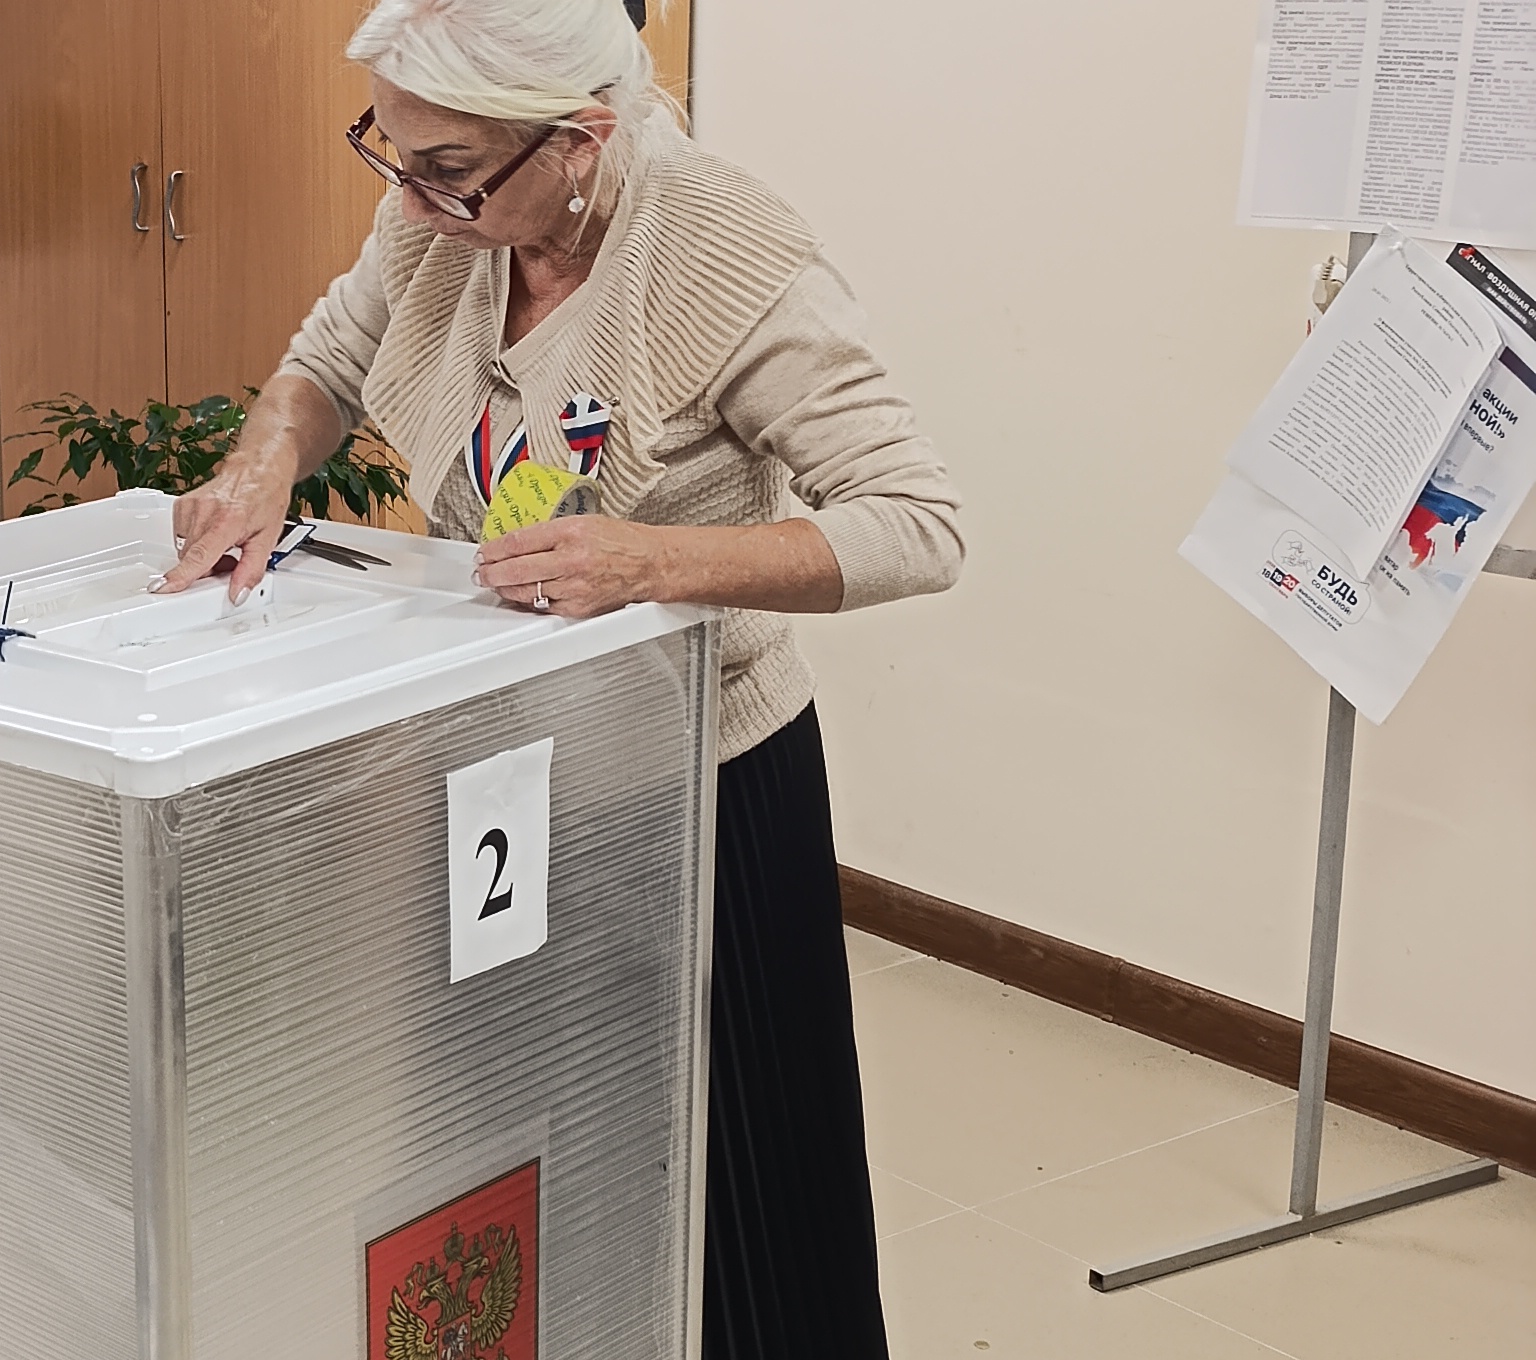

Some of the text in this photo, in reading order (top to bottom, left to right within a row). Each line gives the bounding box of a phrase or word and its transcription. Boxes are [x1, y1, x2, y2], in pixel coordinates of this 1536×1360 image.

[1458, 247, 1487, 274] СГНАЛ
[1482, 388, 1518, 425] акции
[1463, 423, 1495, 453] впервые?
[1262, 568, 1296, 589] 18 19 20
[1317, 564, 1358, 606] БУДЬ
[1311, 579, 1352, 616] СО СТРАНОЙ!
[475, 827, 514, 922] 2
